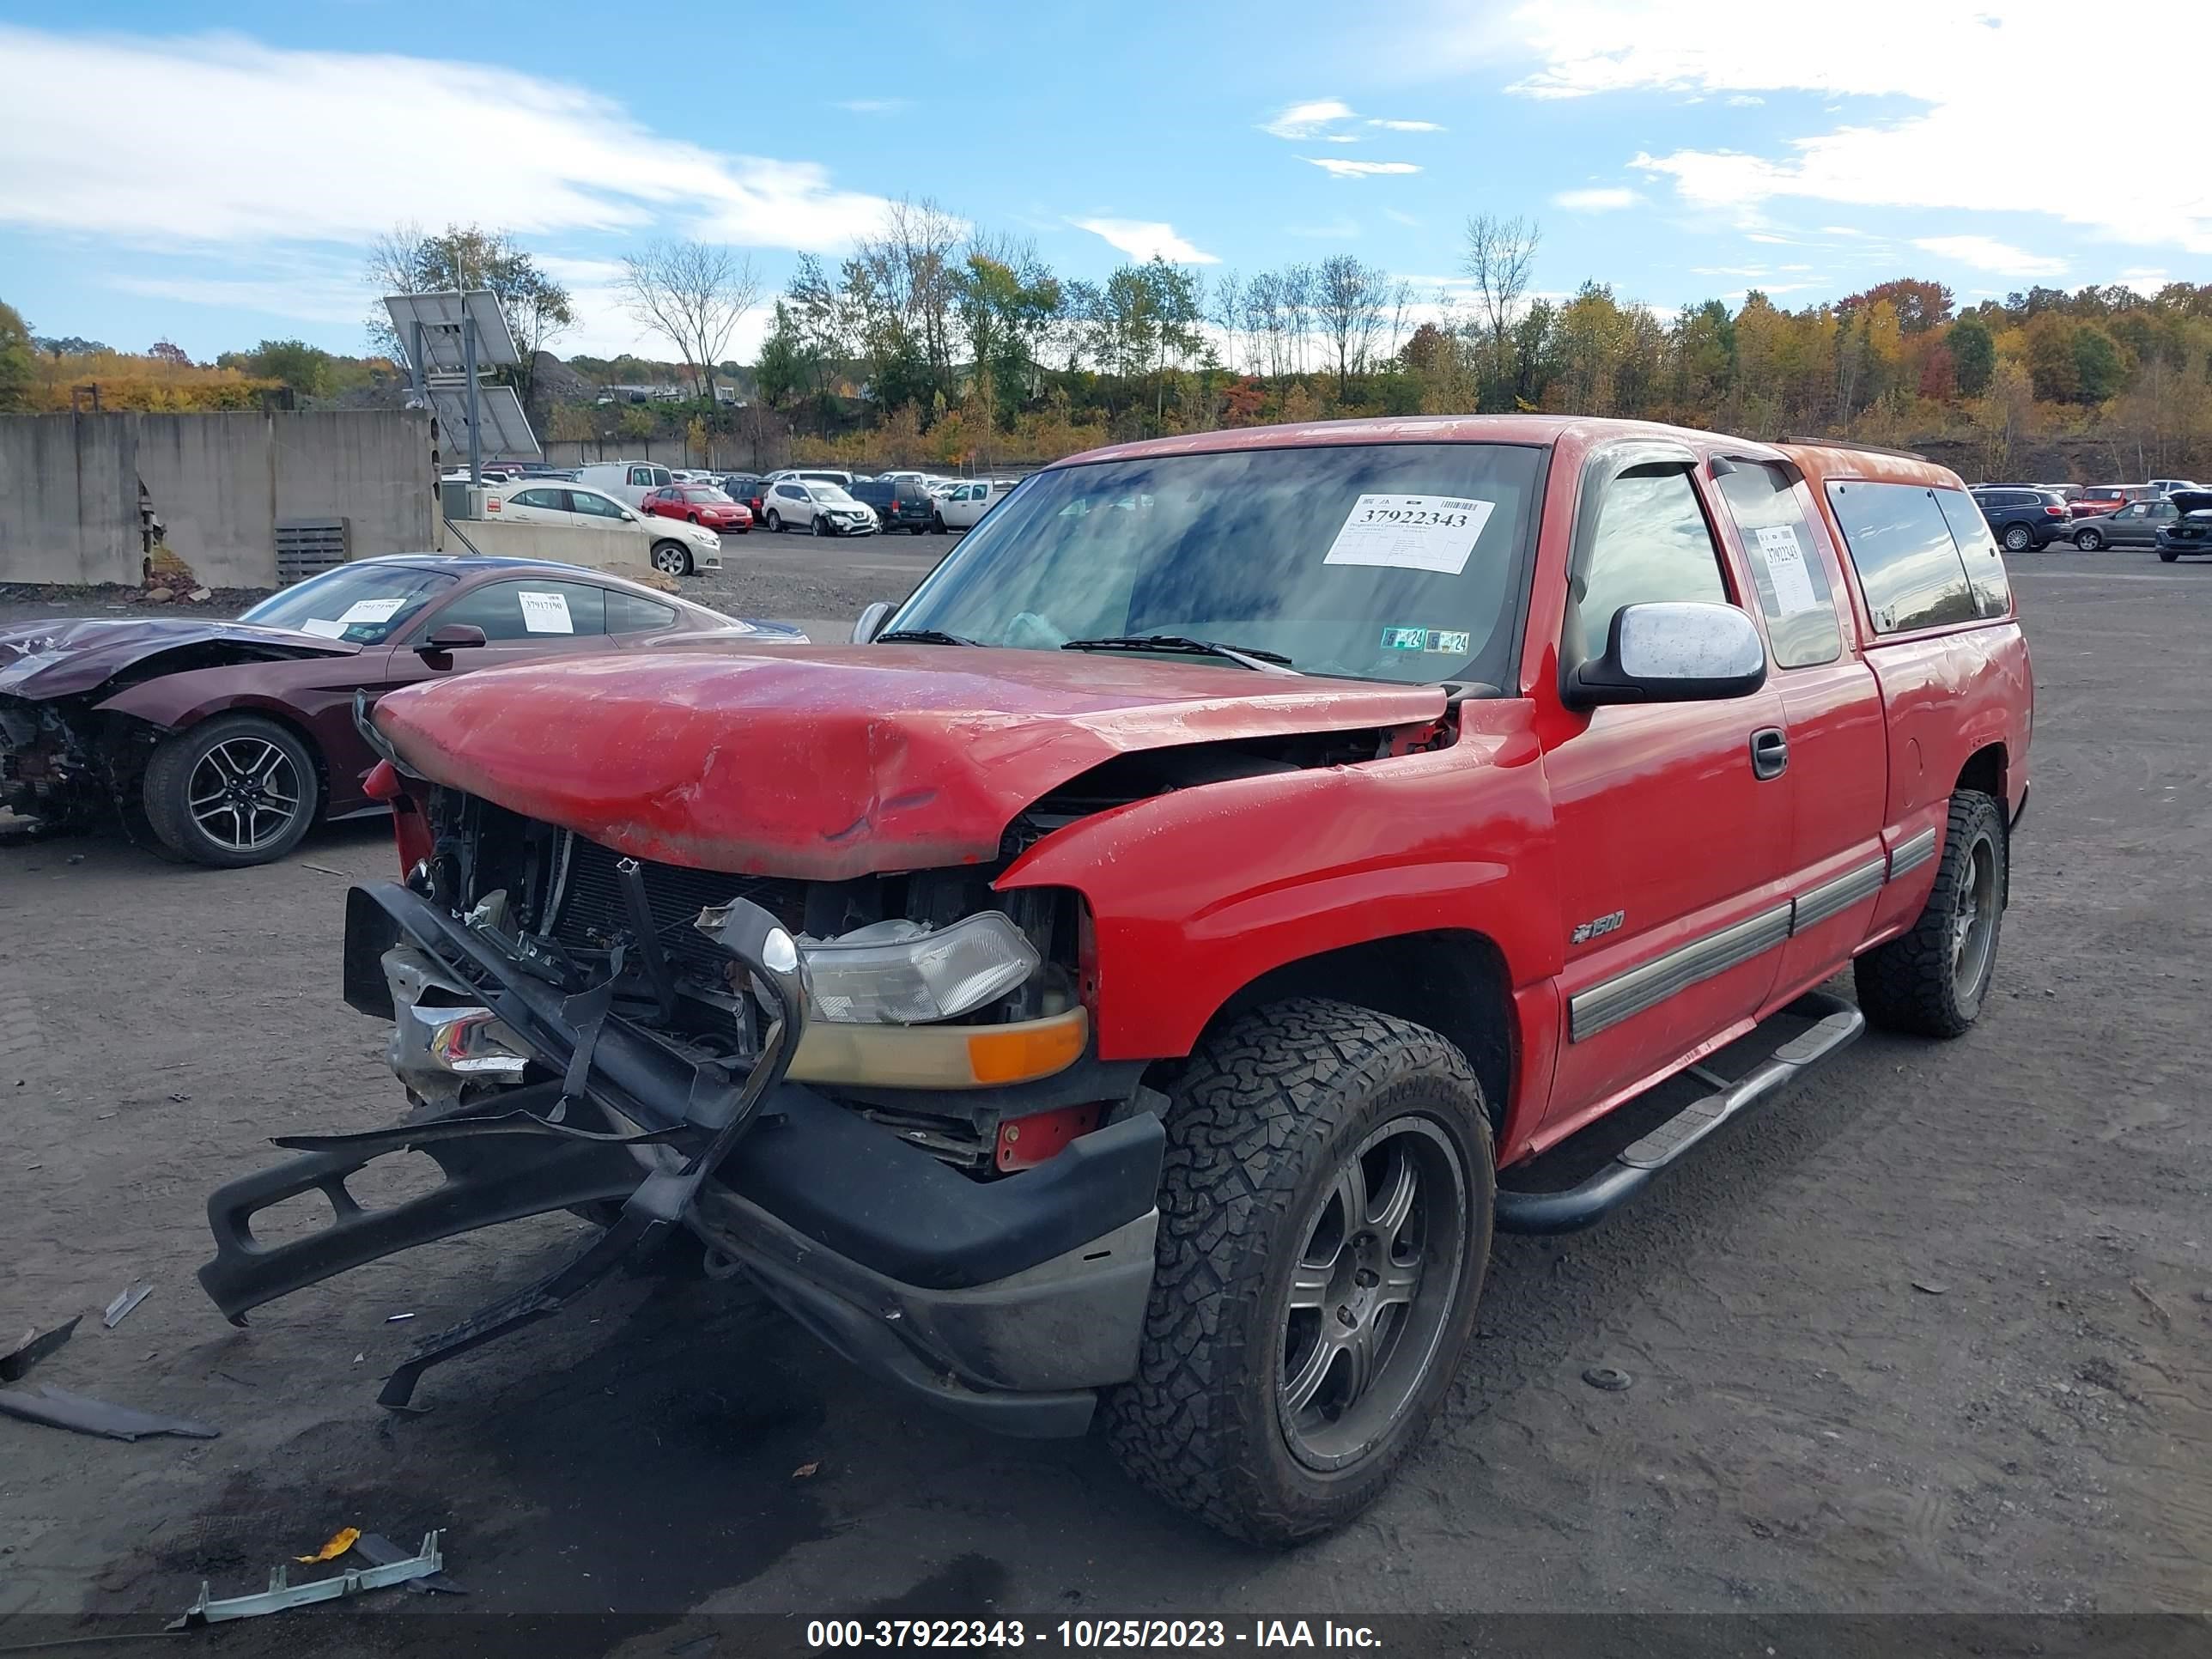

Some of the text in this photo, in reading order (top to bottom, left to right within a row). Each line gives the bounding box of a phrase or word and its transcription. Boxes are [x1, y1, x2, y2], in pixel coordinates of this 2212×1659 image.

[1360, 510, 1468, 528] 37922343
[1766, 544, 1799, 563] 37922343
[1410, 631, 1423, 646] 24
[1455, 635, 1467, 650] 24
[1592, 909, 1625, 937] 1500
